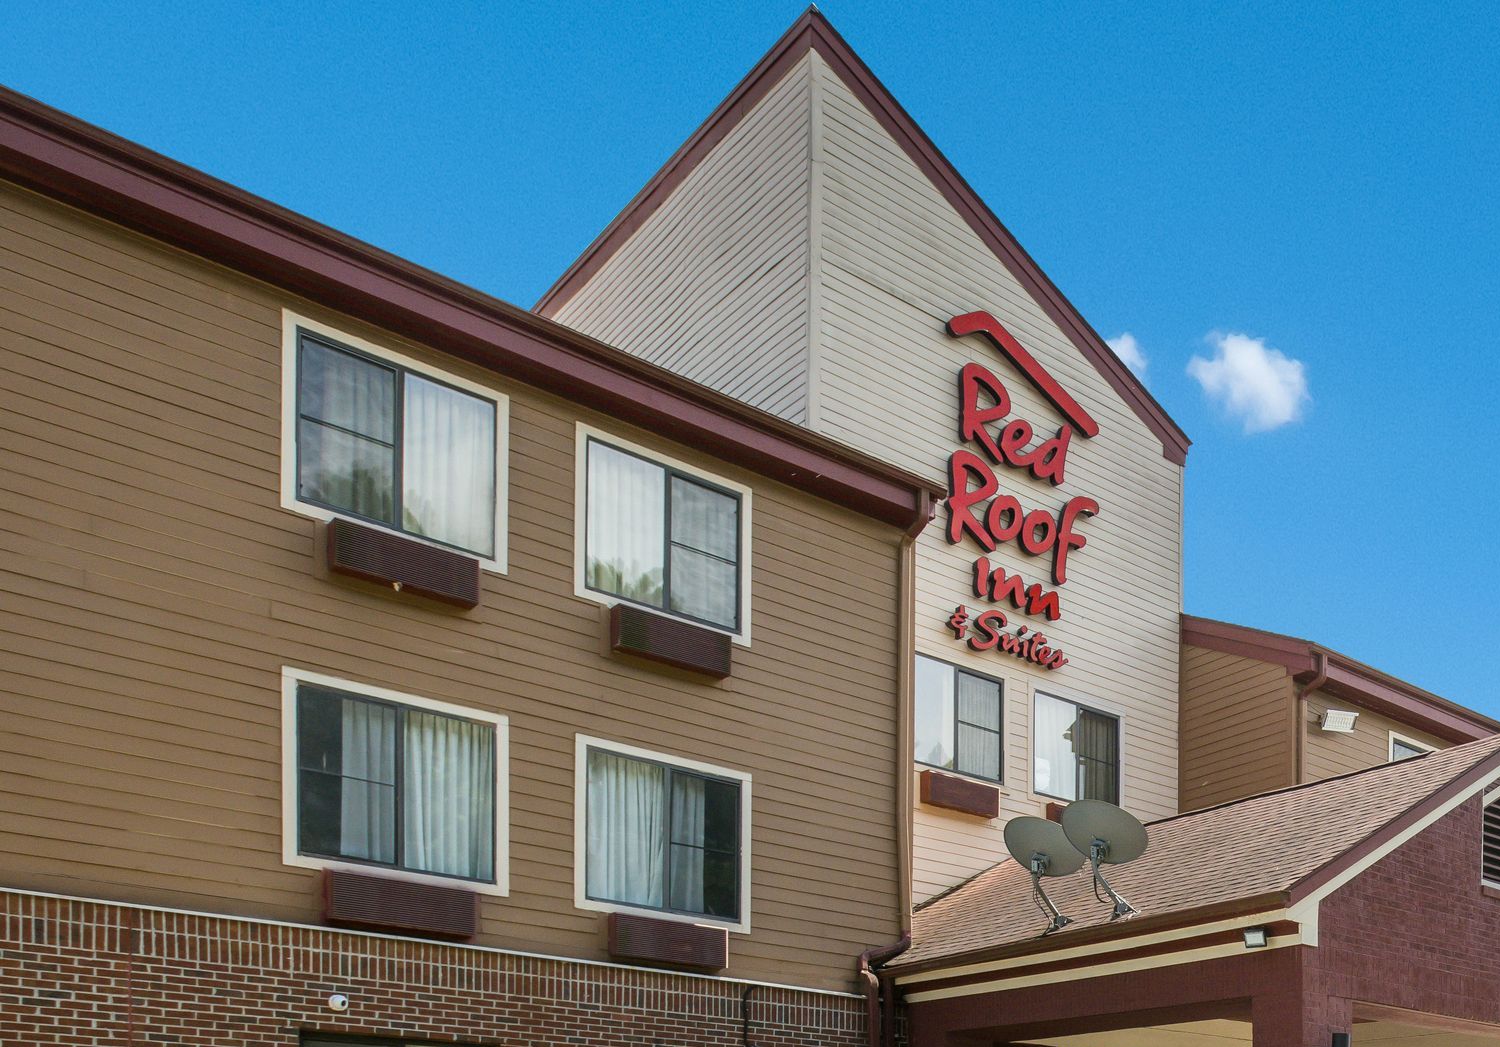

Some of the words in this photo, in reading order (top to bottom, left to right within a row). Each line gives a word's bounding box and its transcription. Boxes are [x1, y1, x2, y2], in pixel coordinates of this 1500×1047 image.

[959, 363, 1072, 486] Red
[946, 450, 1099, 585] Roof
[972, 556, 1061, 621] Inn
[945, 604, 969, 640] &
[967, 610, 1069, 670] Suites
